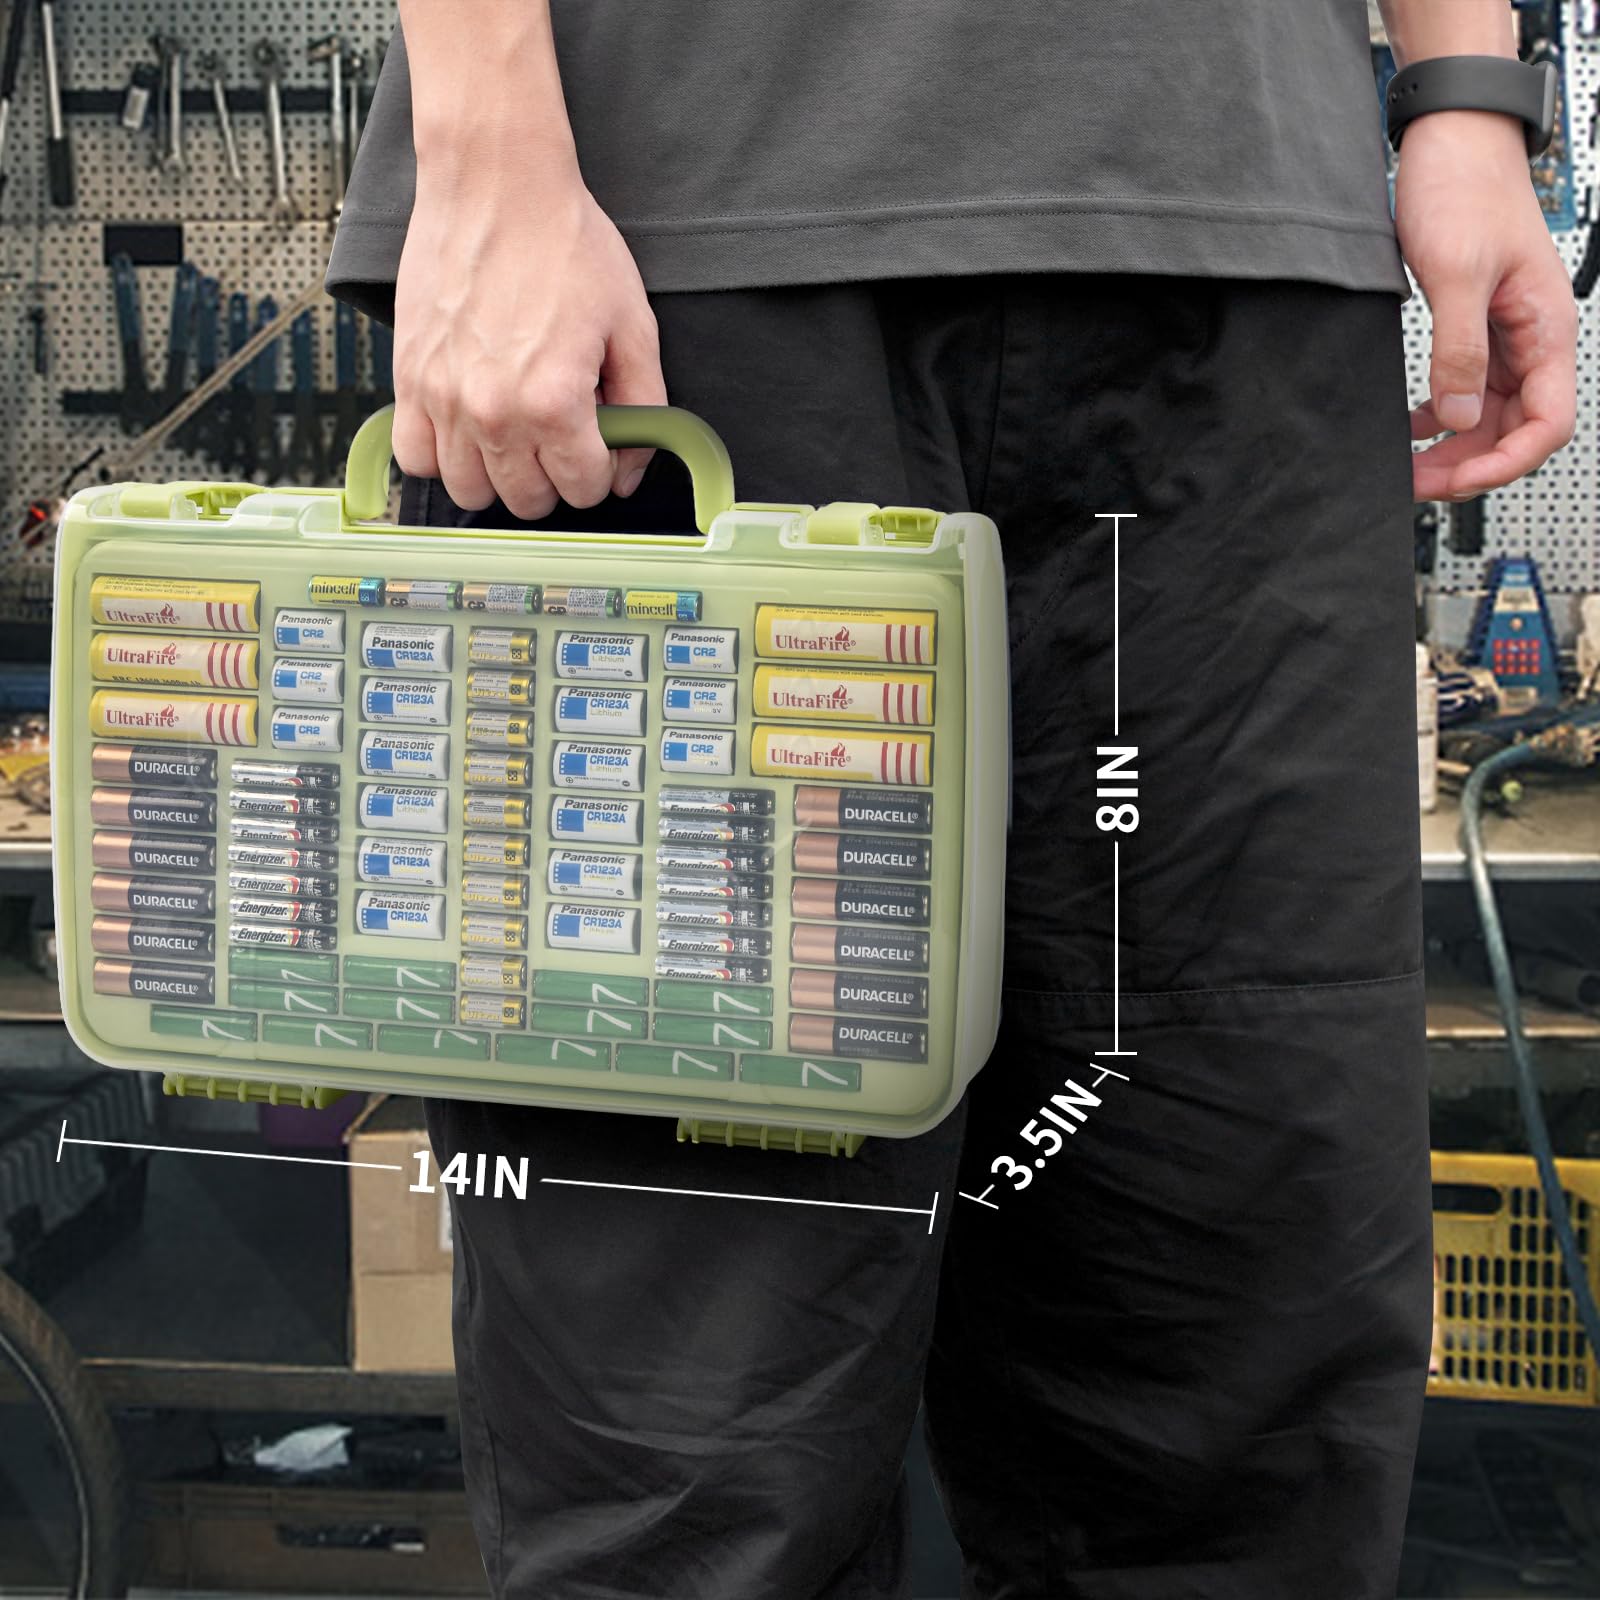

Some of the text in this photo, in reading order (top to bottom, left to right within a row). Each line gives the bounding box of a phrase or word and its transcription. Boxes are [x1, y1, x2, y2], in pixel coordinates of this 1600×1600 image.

[280, 615, 333, 625] Panasonic
[302, 628, 324, 638] CR2
[670, 632, 725, 644] Panasonic
[372, 636, 435, 650] Panasonic
[569, 634, 634, 645] Panasonic
[395, 650, 434, 661] CR123A
[591, 645, 631, 656] CR123A
[693, 647, 716, 657] CR2
[280, 659, 332, 668] Panasonic
[300, 671, 322, 680] CR2
[374, 681, 437, 694] Panasonic
[672, 679, 727, 689] Panasonic
[396, 694, 435, 705] CR123A
[568, 688, 632, 699] Panasonic
[693, 691, 717, 701] CR2
[590, 699, 629, 710] CR123A
[278, 711, 330, 722] Panasonic
[298, 725, 320, 735] CR2
[669, 731, 723, 741] Panasonic
[372, 737, 435, 750] Panasonic
[691, 744, 714, 754] CR2
[395, 750, 433, 761] CR123A
[567, 744, 632, 756] Panasonic
[589, 755, 629, 767] CR123A
[134, 761, 196, 776] DURACELL
[375, 786, 437, 797] Panasonic
[396, 796, 435, 807] CR123A
[564, 799, 628, 812] Panasonic
[133, 809, 196, 823] DURACELL
[586, 811, 626, 823] CR123A
[844, 808, 914, 823] DURACELL
[370, 843, 433, 856] Panasonic
[134, 851, 196, 867] DURACELL
[392, 856, 430, 867] CR123A
[561, 852, 626, 865] Panasonic
[843, 851, 913, 866] DURACELL
[583, 864, 623, 876] CR123A
[133, 894, 195, 910] DURACELL
[368, 897, 431, 911] Panasonic
[560, 905, 626, 918] Panasonic
[841, 901, 912, 917] DURACELL
[390, 911, 428, 923] CR123A
[583, 917, 622, 929] CR123A
[133, 935, 194, 950] DURACELL
[840, 945, 911, 961] DURACELL
[134, 979, 193, 994] DURACELL
[840, 988, 910, 1004] DURACELL
[839, 1027, 909, 1044] DURACELL
